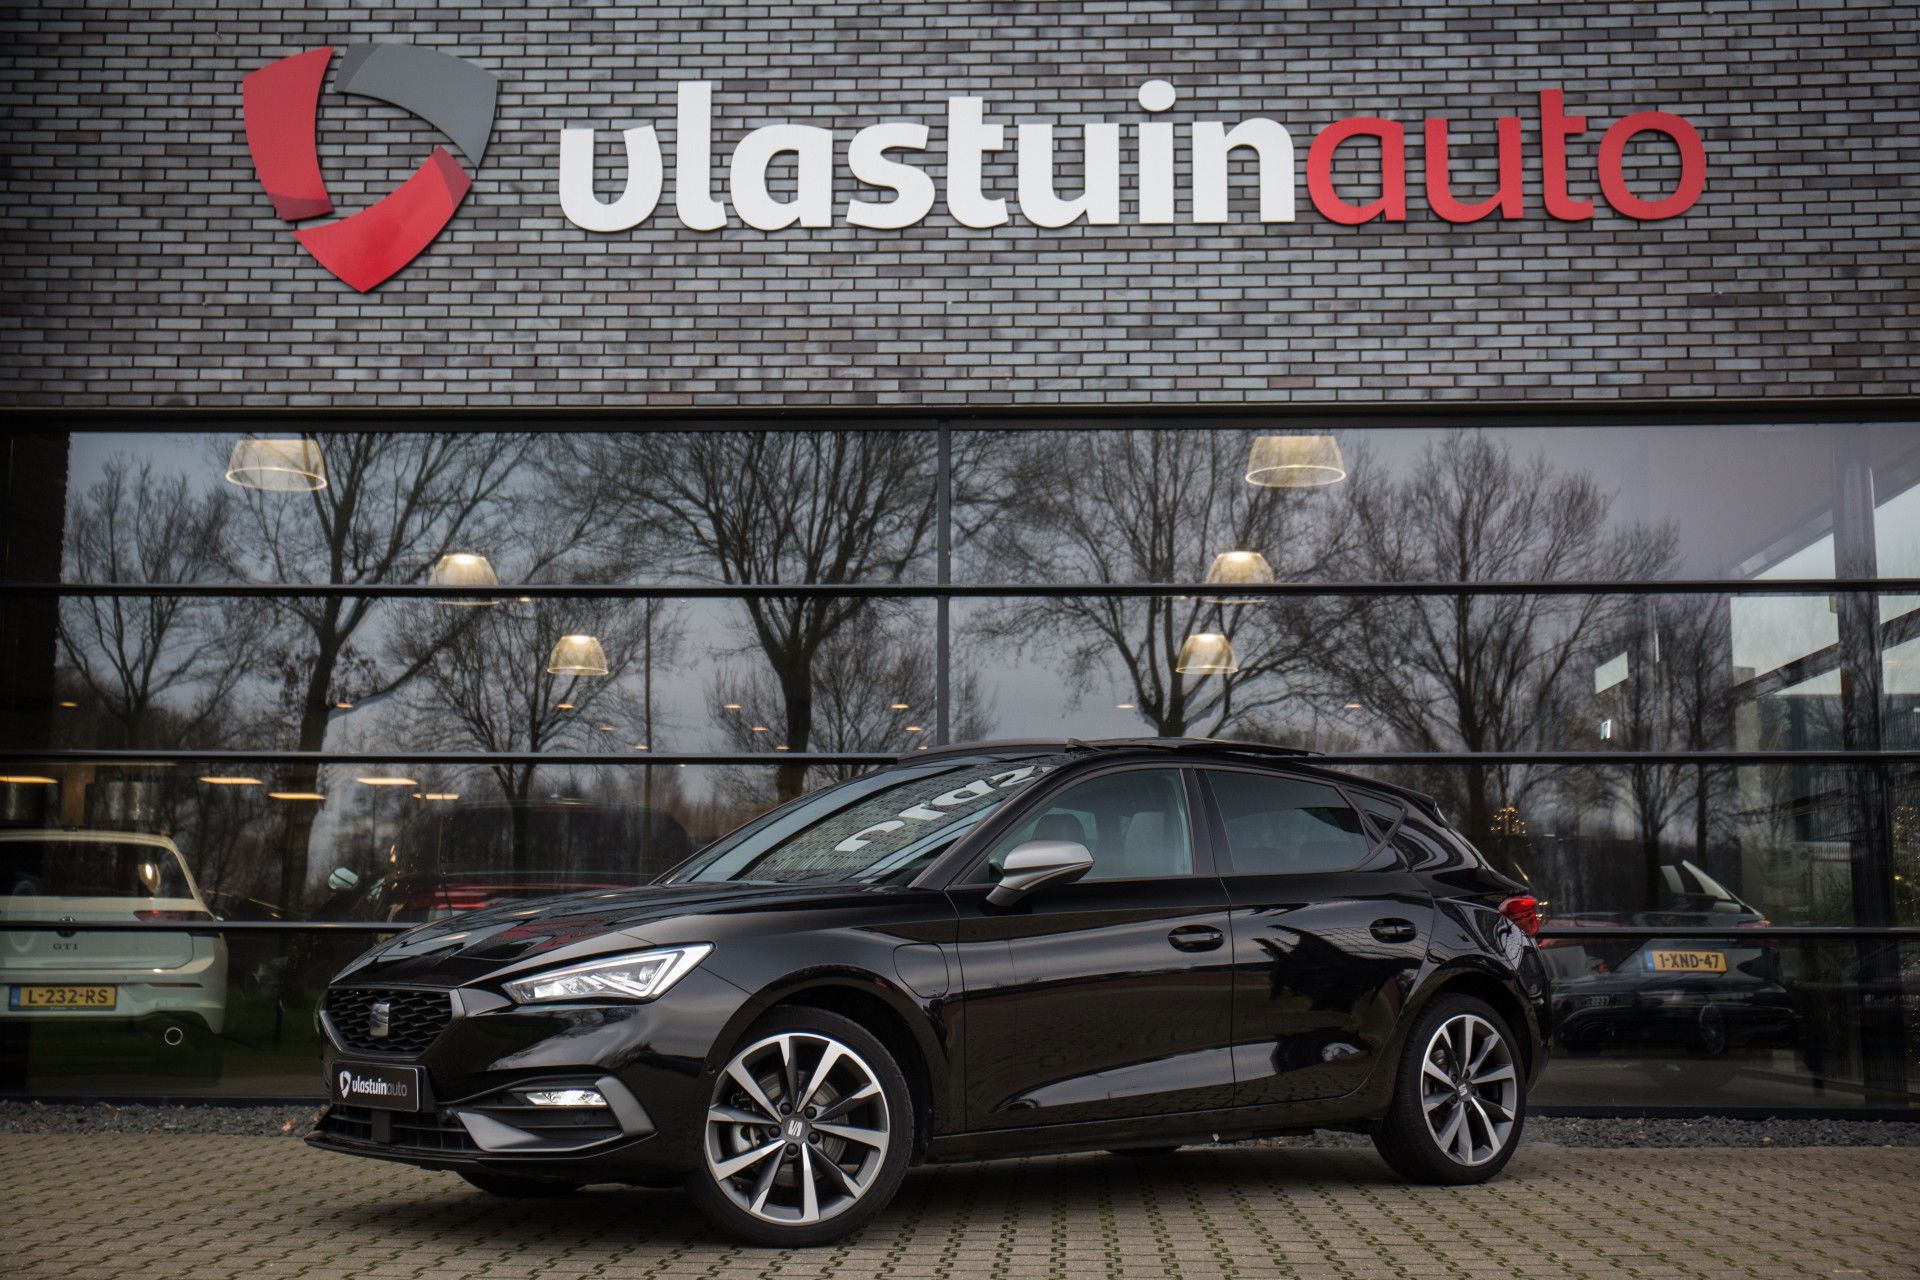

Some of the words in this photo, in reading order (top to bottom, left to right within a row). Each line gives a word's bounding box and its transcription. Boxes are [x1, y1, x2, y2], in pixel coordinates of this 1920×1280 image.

[53, 942, 78, 951] GTI
[1659, 953, 1719, 969] 1-XND-47
[28, 989, 108, 1004] L-232-RS
